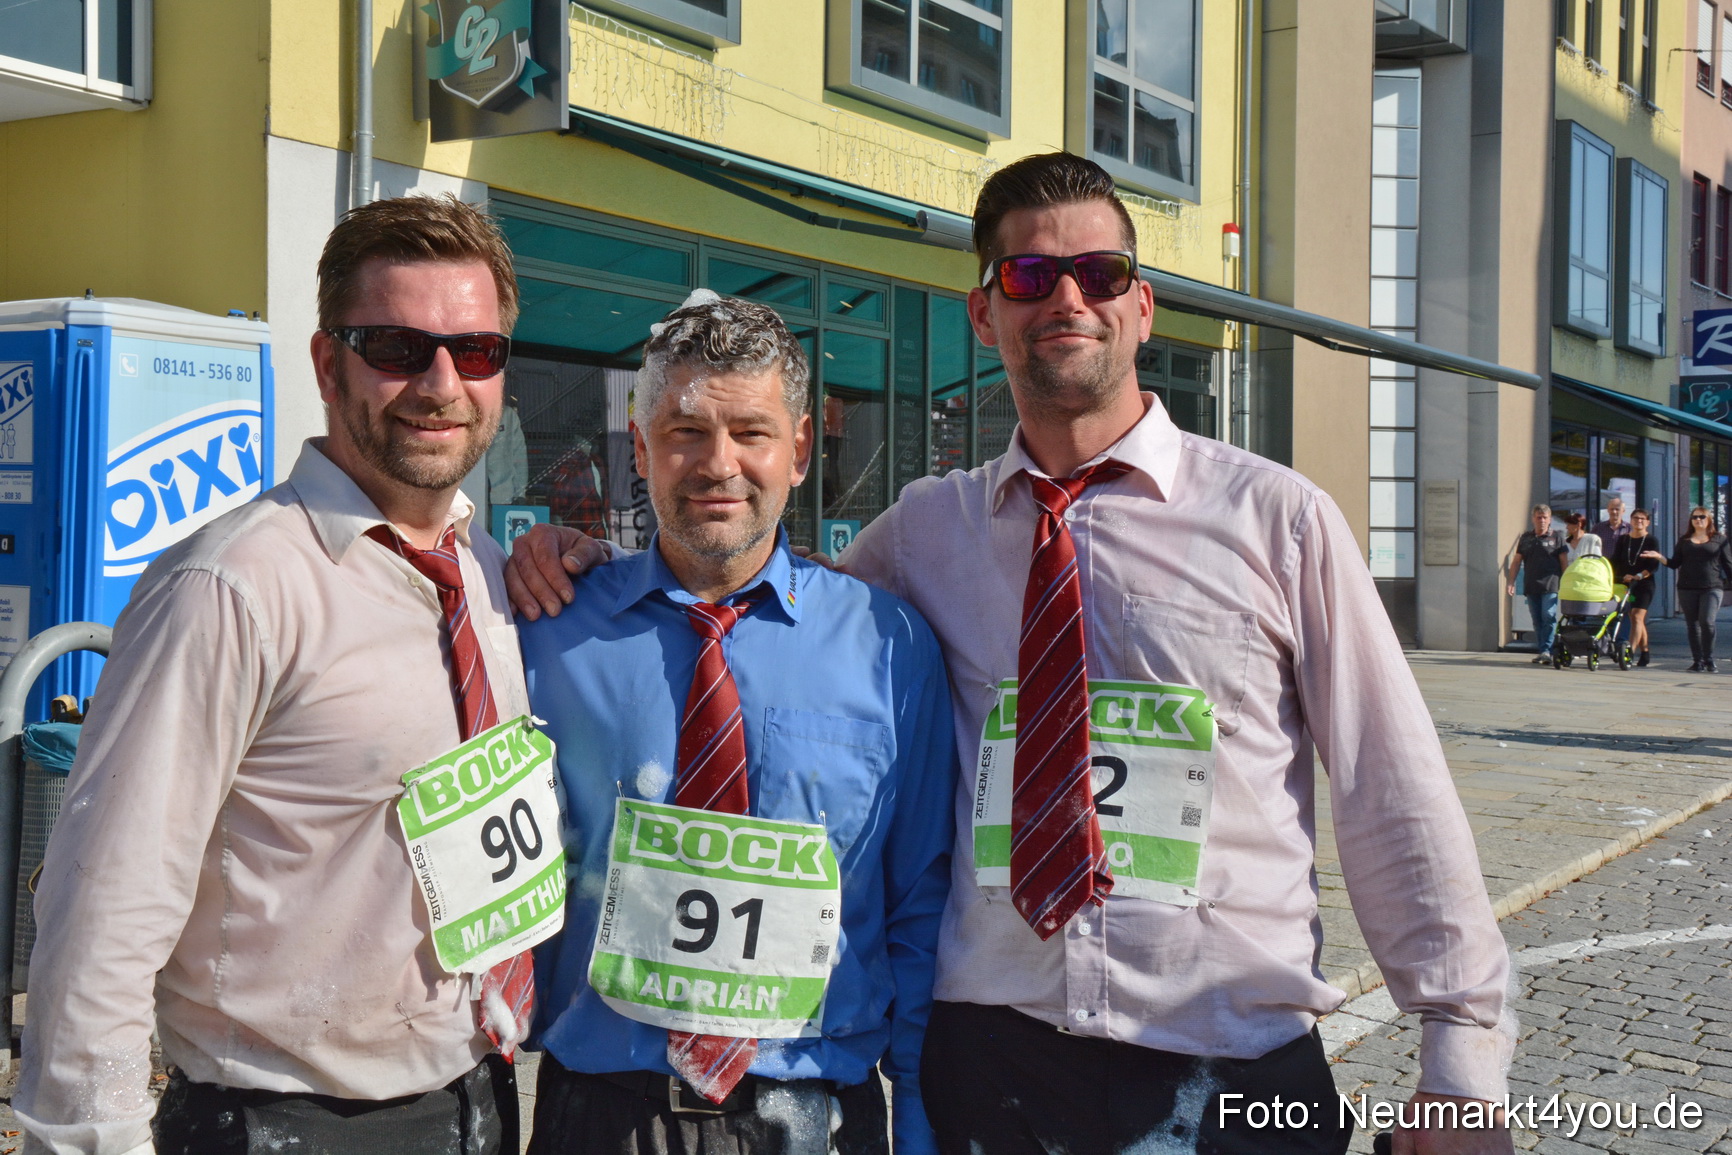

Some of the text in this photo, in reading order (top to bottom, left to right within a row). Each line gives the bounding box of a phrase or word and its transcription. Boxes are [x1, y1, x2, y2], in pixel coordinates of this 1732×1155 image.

[454, 5, 500, 76] G2
[153, 356, 195, 378] 08141
[208, 360, 232, 381] 536
[236, 363, 252, 383] 80
[1698, 390, 1720, 414] G2
[413, 724, 537, 820] BOCK
[547, 776, 558, 790] E6
[1091, 755, 1129, 818] 2
[1187, 769, 1205, 781] E6
[480, 797, 543, 884] 90
[631, 814, 826, 879] BOCK
[1107, 841, 1134, 868] O
[460, 862, 567, 953] MATTHIA
[671, 888, 764, 961] 91
[820, 908, 834, 920] E6
[639, 972, 780, 1012] ADRIAN
